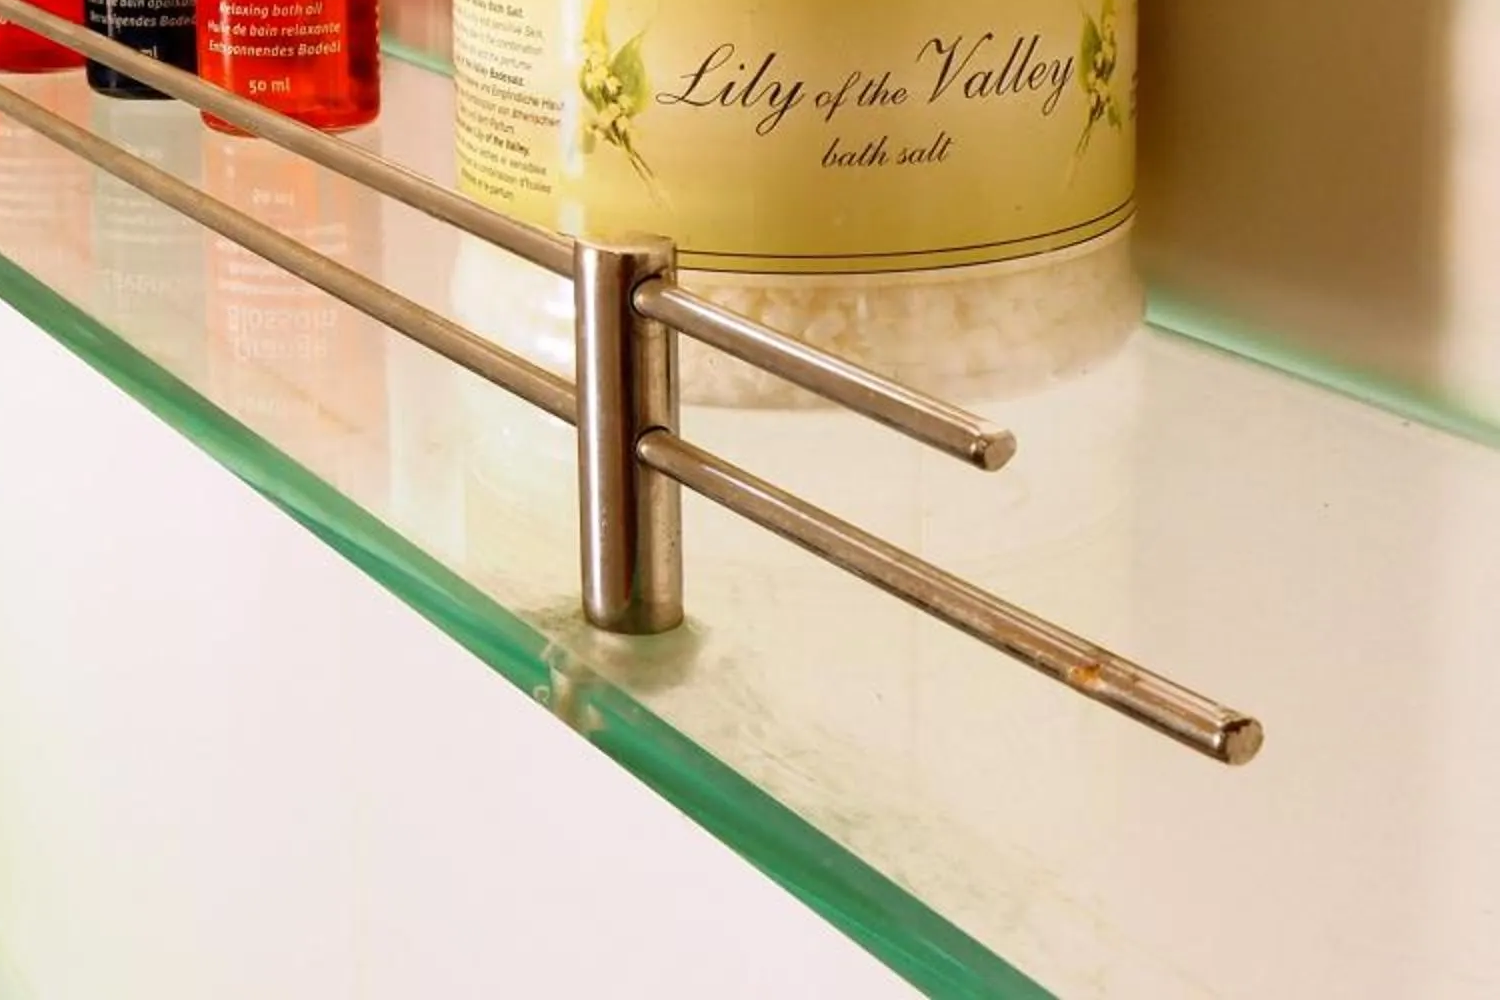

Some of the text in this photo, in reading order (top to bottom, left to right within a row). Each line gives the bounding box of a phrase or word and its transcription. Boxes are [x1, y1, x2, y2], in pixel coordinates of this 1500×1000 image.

[219, 1, 323, 19] Relaxing bath oil
[232, 22, 247, 37] de
[249, 23, 278, 38] bain
[281, 21, 341, 37] relaxante
[248, 77, 291, 94] 50 ml
[655, 32, 1074, 136] Lily of the Valley
[821, 131, 953, 168] bath salt
